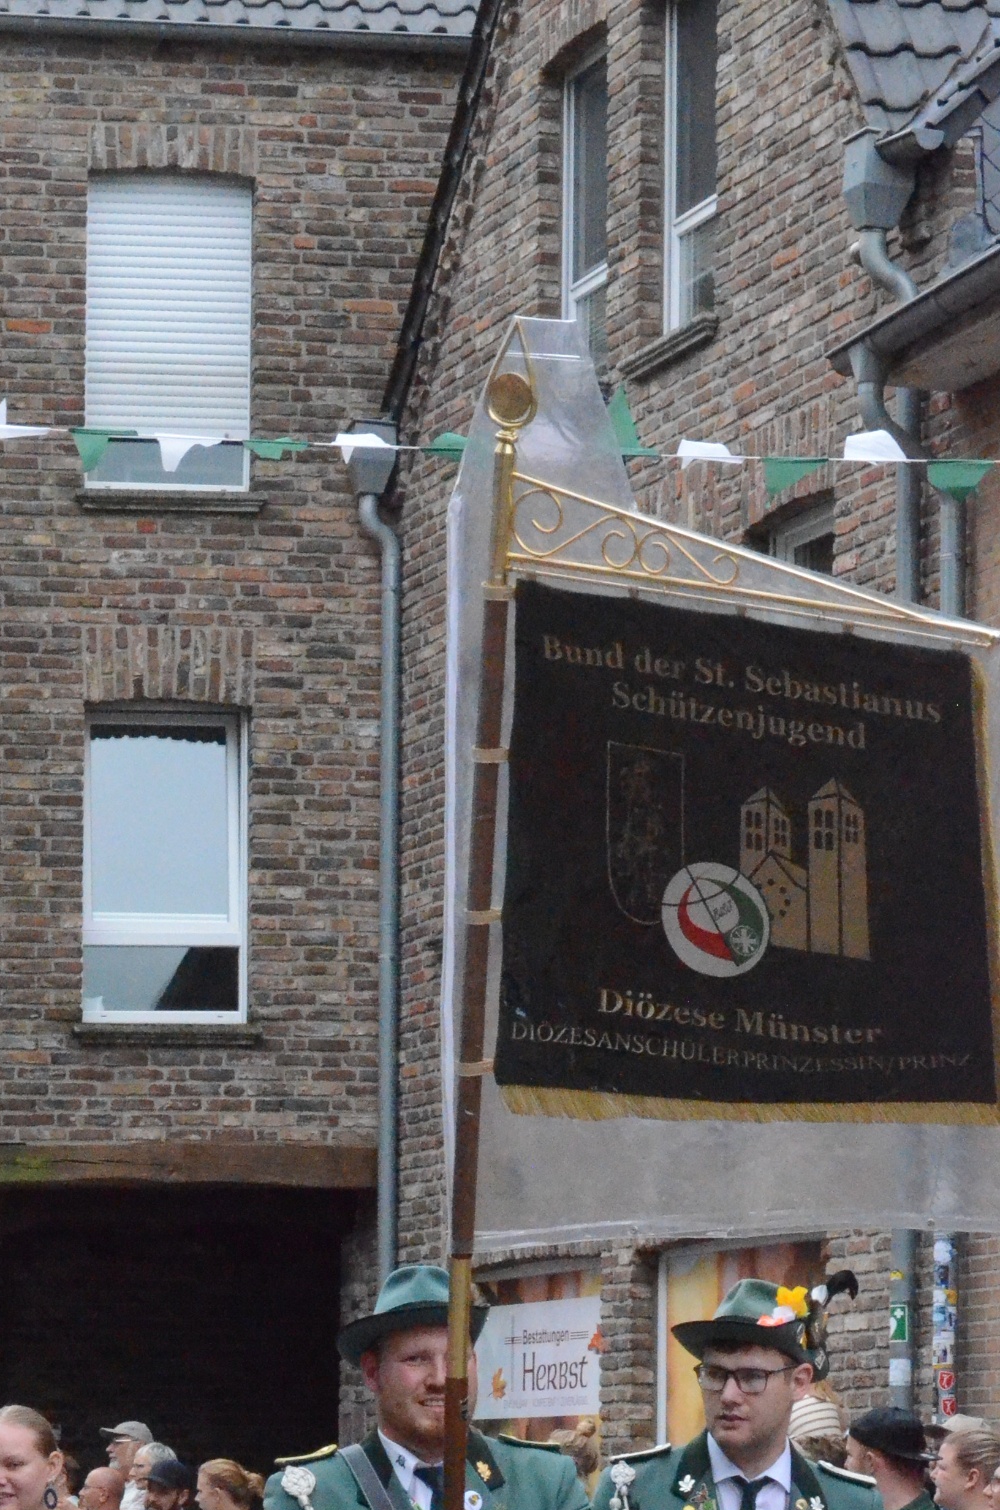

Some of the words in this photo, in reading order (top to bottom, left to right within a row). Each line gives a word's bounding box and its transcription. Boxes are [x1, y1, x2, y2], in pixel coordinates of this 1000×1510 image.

[543, 634, 625, 669] Bund
[634, 646, 686, 679] der
[694, 657, 735, 688] St.
[745, 665, 942, 723] Sebastianus
[612, 681, 866, 749] Schützenjugend
[597, 988, 725, 1030] Diözese
[734, 1008, 883, 1044] Münster
[523, 1330, 569, 1346] Bestattungen
